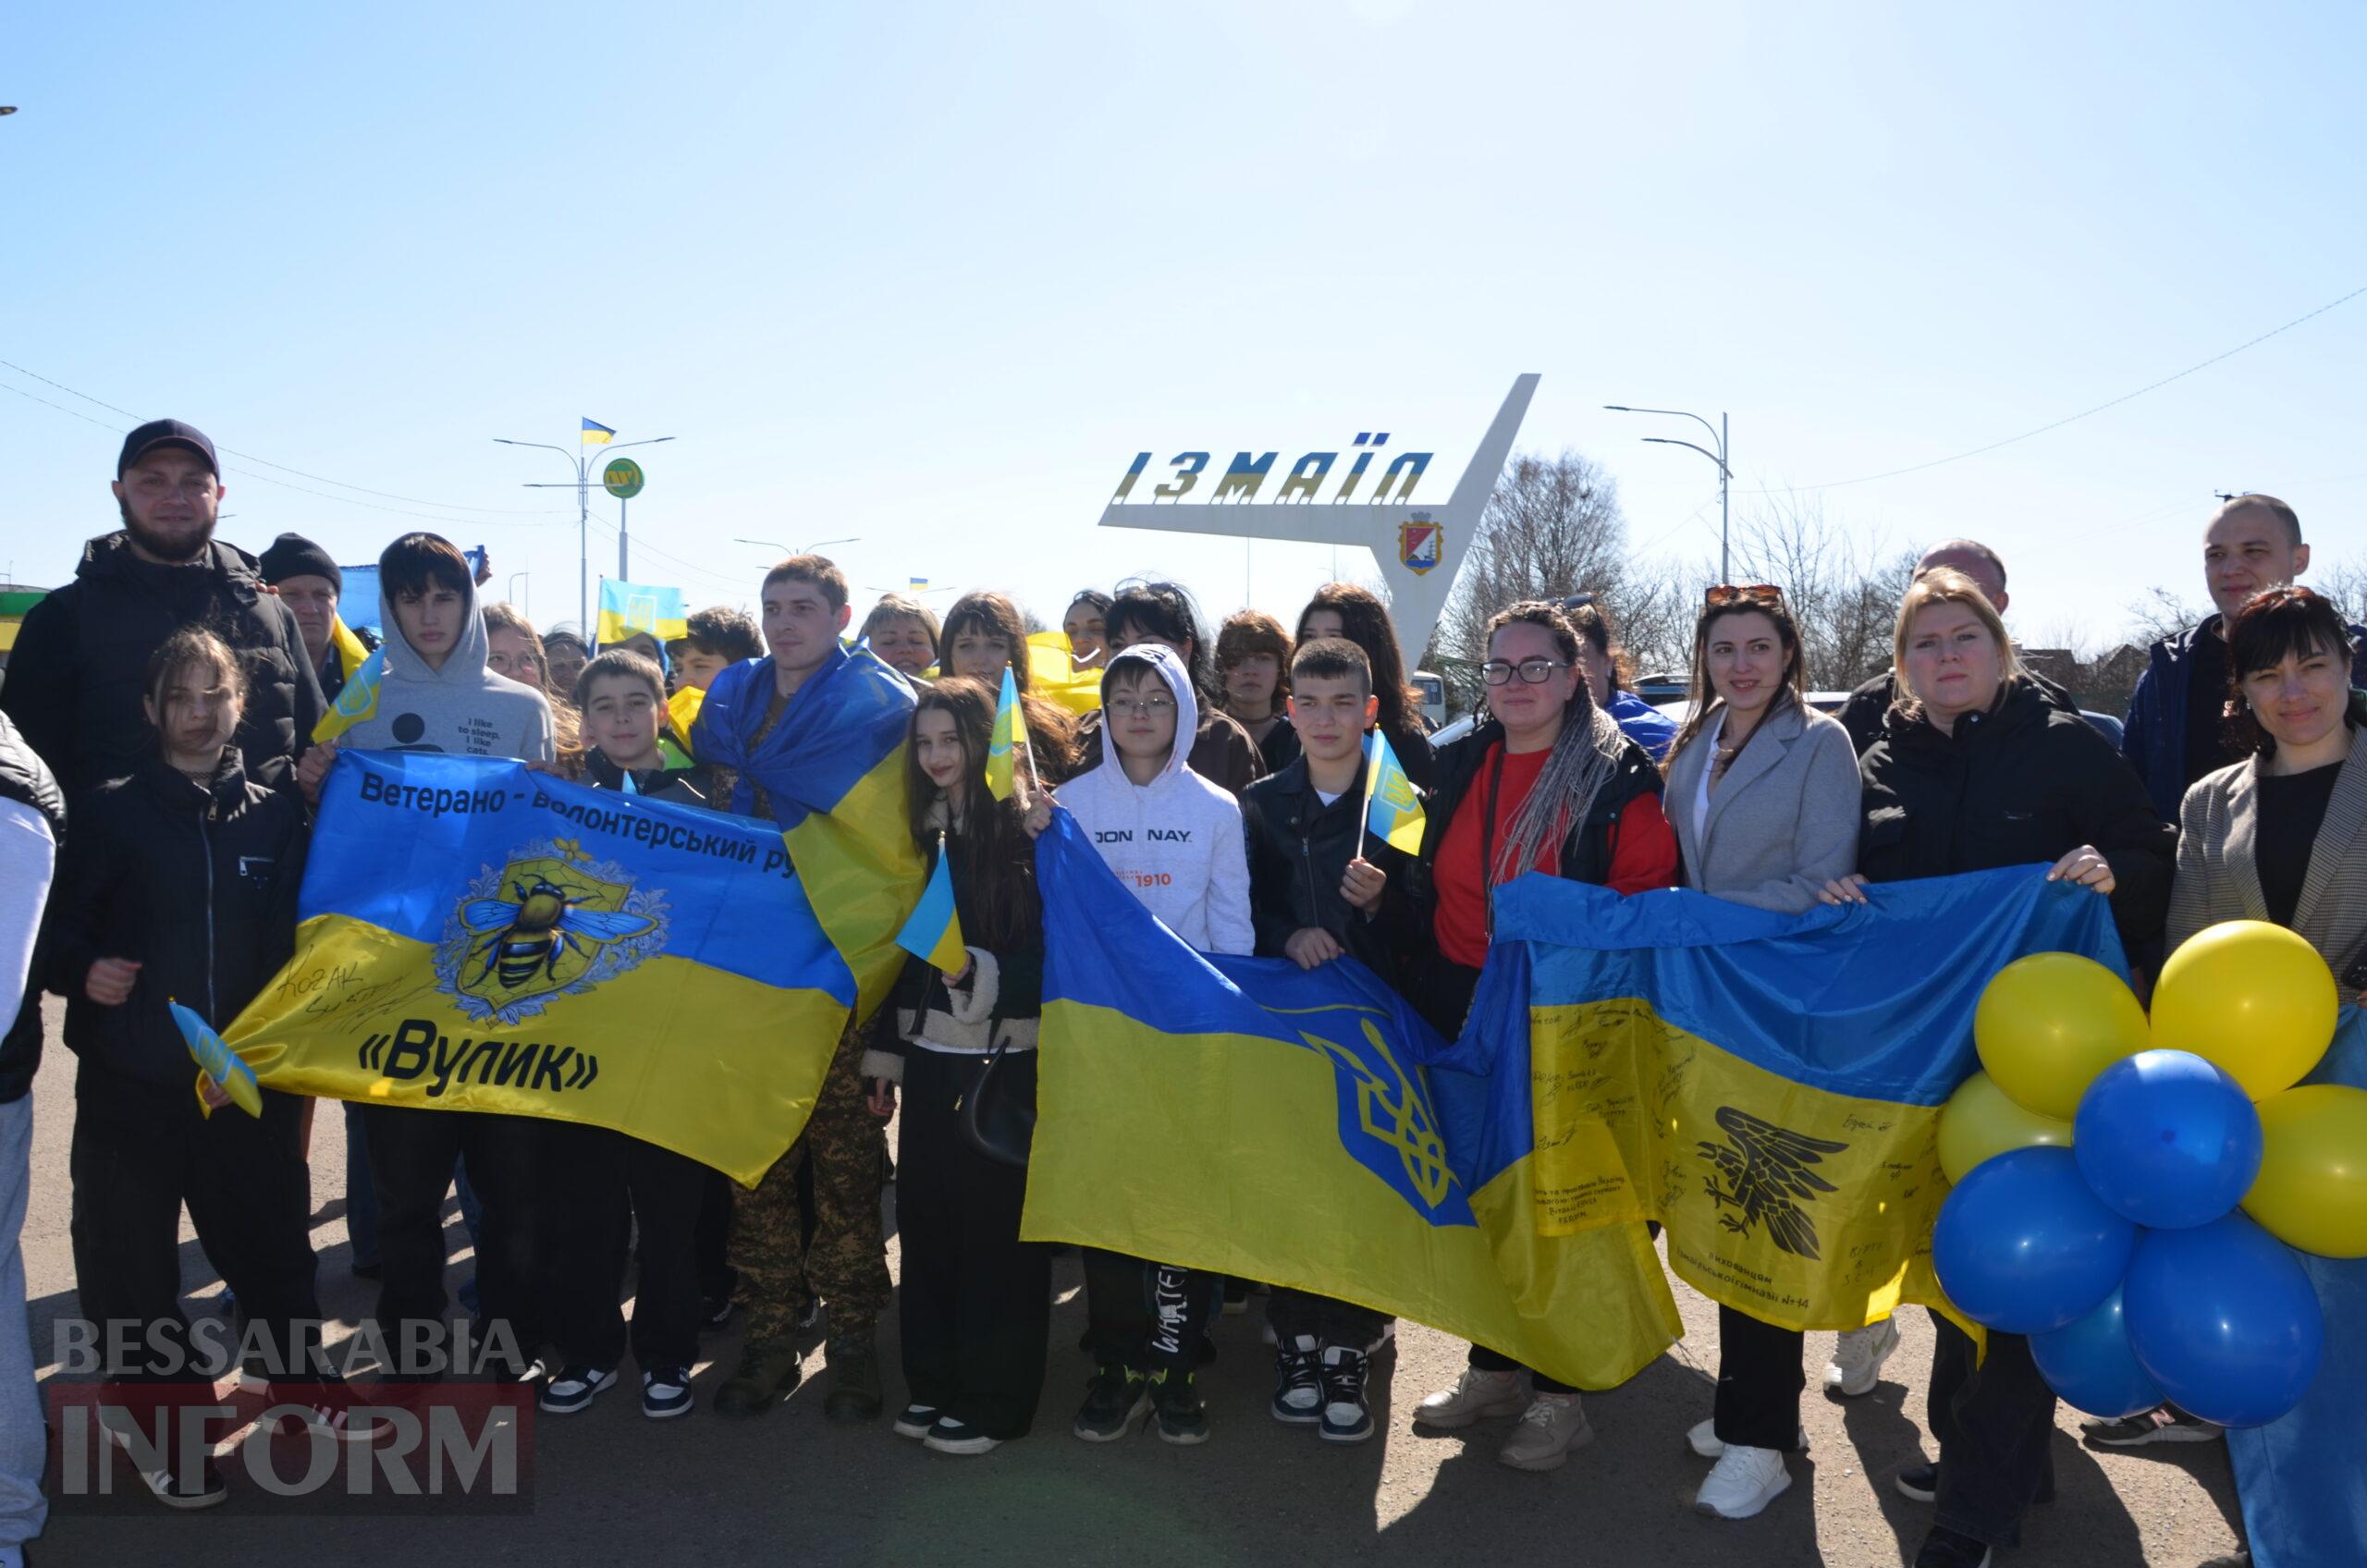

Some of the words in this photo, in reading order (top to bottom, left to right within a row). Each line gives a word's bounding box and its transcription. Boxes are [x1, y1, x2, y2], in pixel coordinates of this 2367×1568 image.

[474, 717, 493, 729] like
[458, 726, 470, 734] to
[473, 737, 492, 747] like
[361, 771, 505, 819] Ветерано
[1135, 873, 1172, 888] 1910
[358, 1019, 599, 1097] «Вулик»
